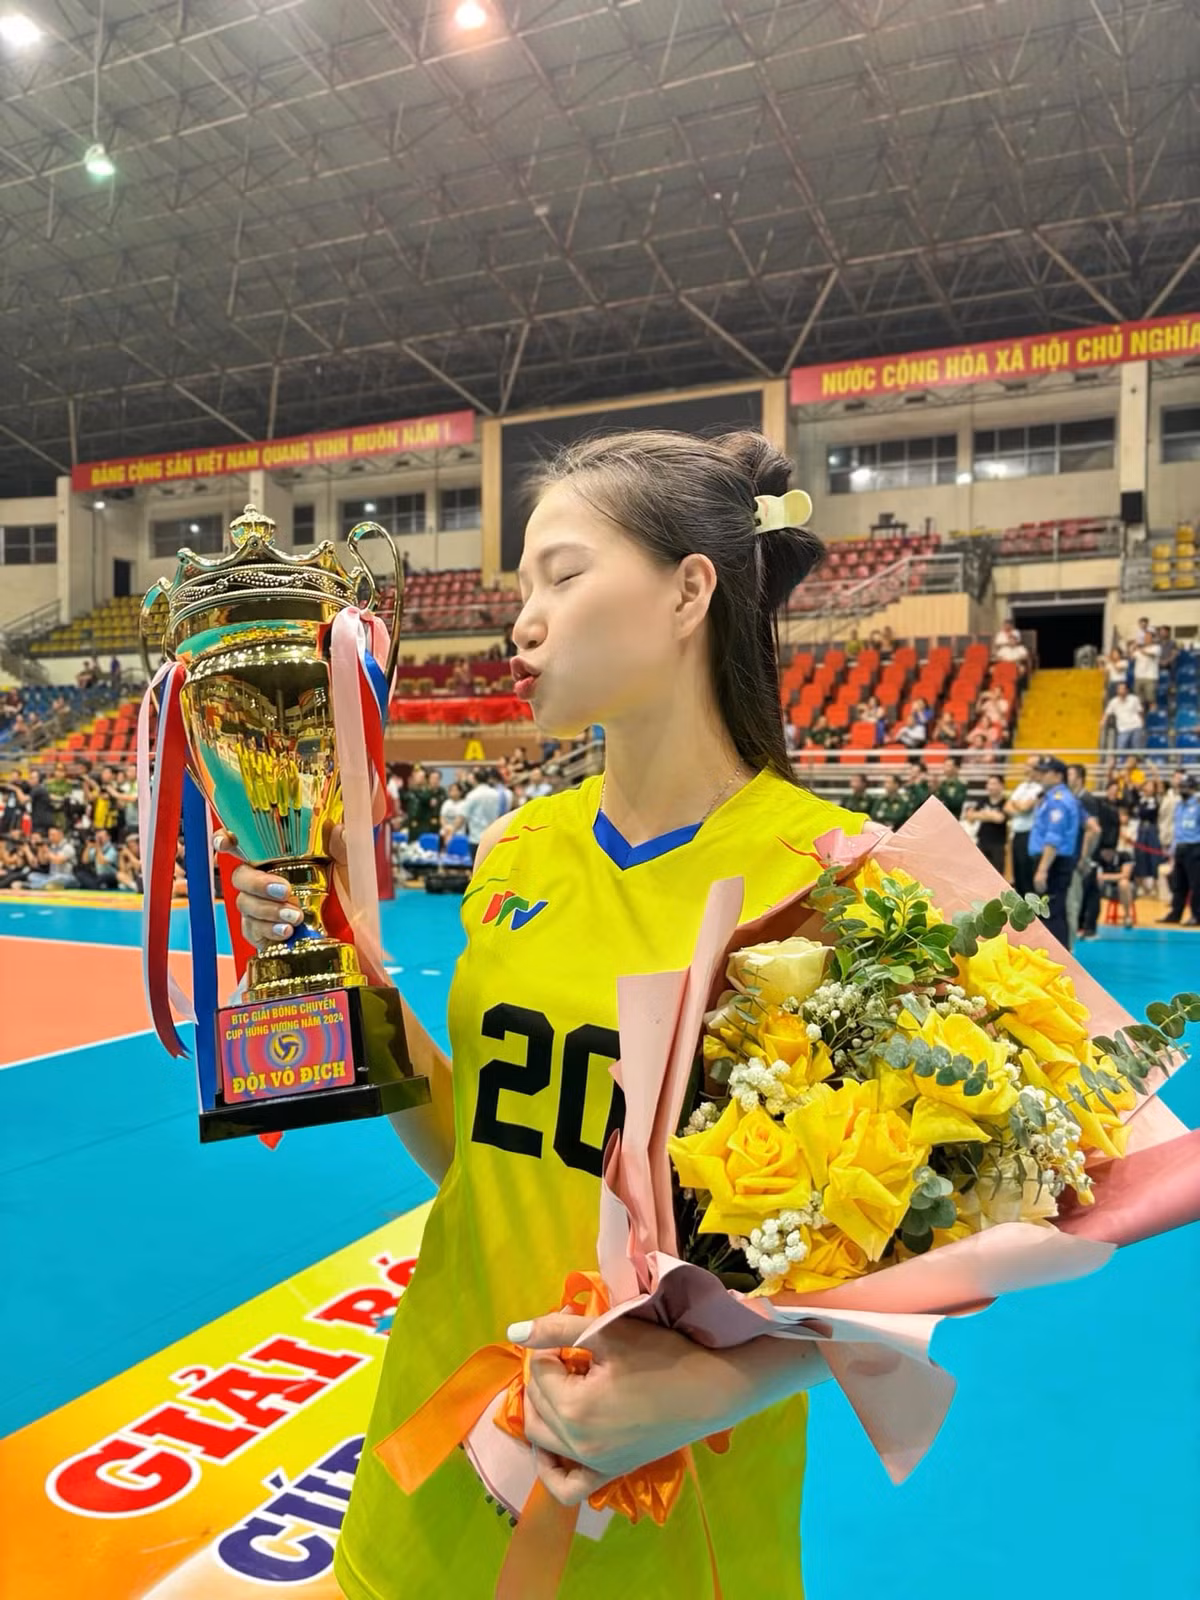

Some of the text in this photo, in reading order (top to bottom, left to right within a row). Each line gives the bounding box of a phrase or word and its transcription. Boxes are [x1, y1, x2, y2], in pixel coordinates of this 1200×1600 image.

[821, 319, 1200, 397] NƯỚC CỘNG HÒA XÃ HỘI CHỦ NGHĨA
[91, 461, 125, 486] ĐẢNG
[127, 458, 163, 484] CỘNG
[165, 452, 193, 477] SẢN
[195, 450, 224, 476] VIỆT
[226, 447, 259, 469] NAM
[262, 441, 310, 466] QUANG
[313, 435, 349, 459] VINH
[352, 426, 399, 454] MUÔN
[402, 420, 439, 446] NĂM
[225, 1012, 344, 1040] CUP HÙNG VƯƠNG NĂM 2024
[231, 1012, 250, 1026] BTC
[251, 1006, 271, 1022] GIẢI
[272, 1004, 298, 1019] BÓNG
[232, 1061, 346, 1094] ĐỘI VÔ ĐỊCH
[471, 1002, 627, 1178] 20
[50, 1336, 368, 1516] GIẢI
